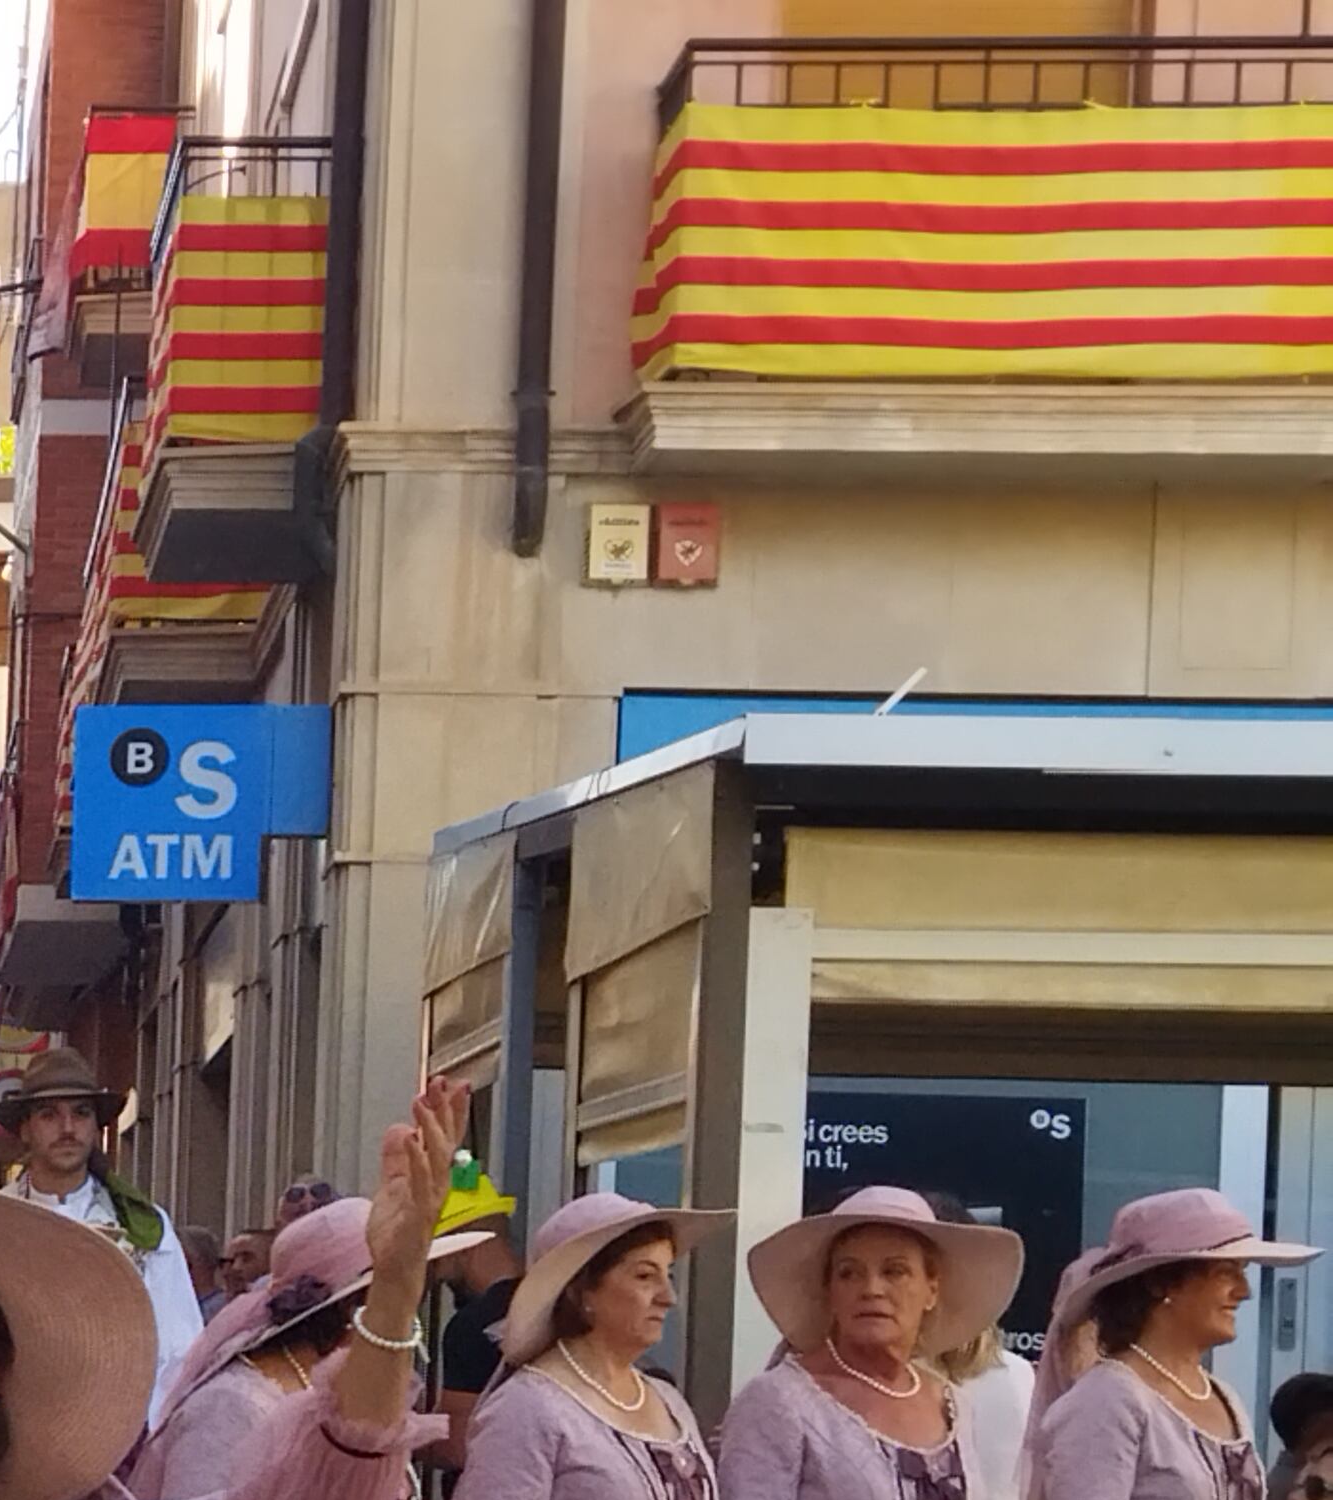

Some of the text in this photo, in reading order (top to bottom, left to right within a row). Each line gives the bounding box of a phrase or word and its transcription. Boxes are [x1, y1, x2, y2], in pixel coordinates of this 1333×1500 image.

[107, 834, 234, 880] ATM
[818, 1123, 890, 1144] crees
[824, 1144, 849, 1173] ti,
